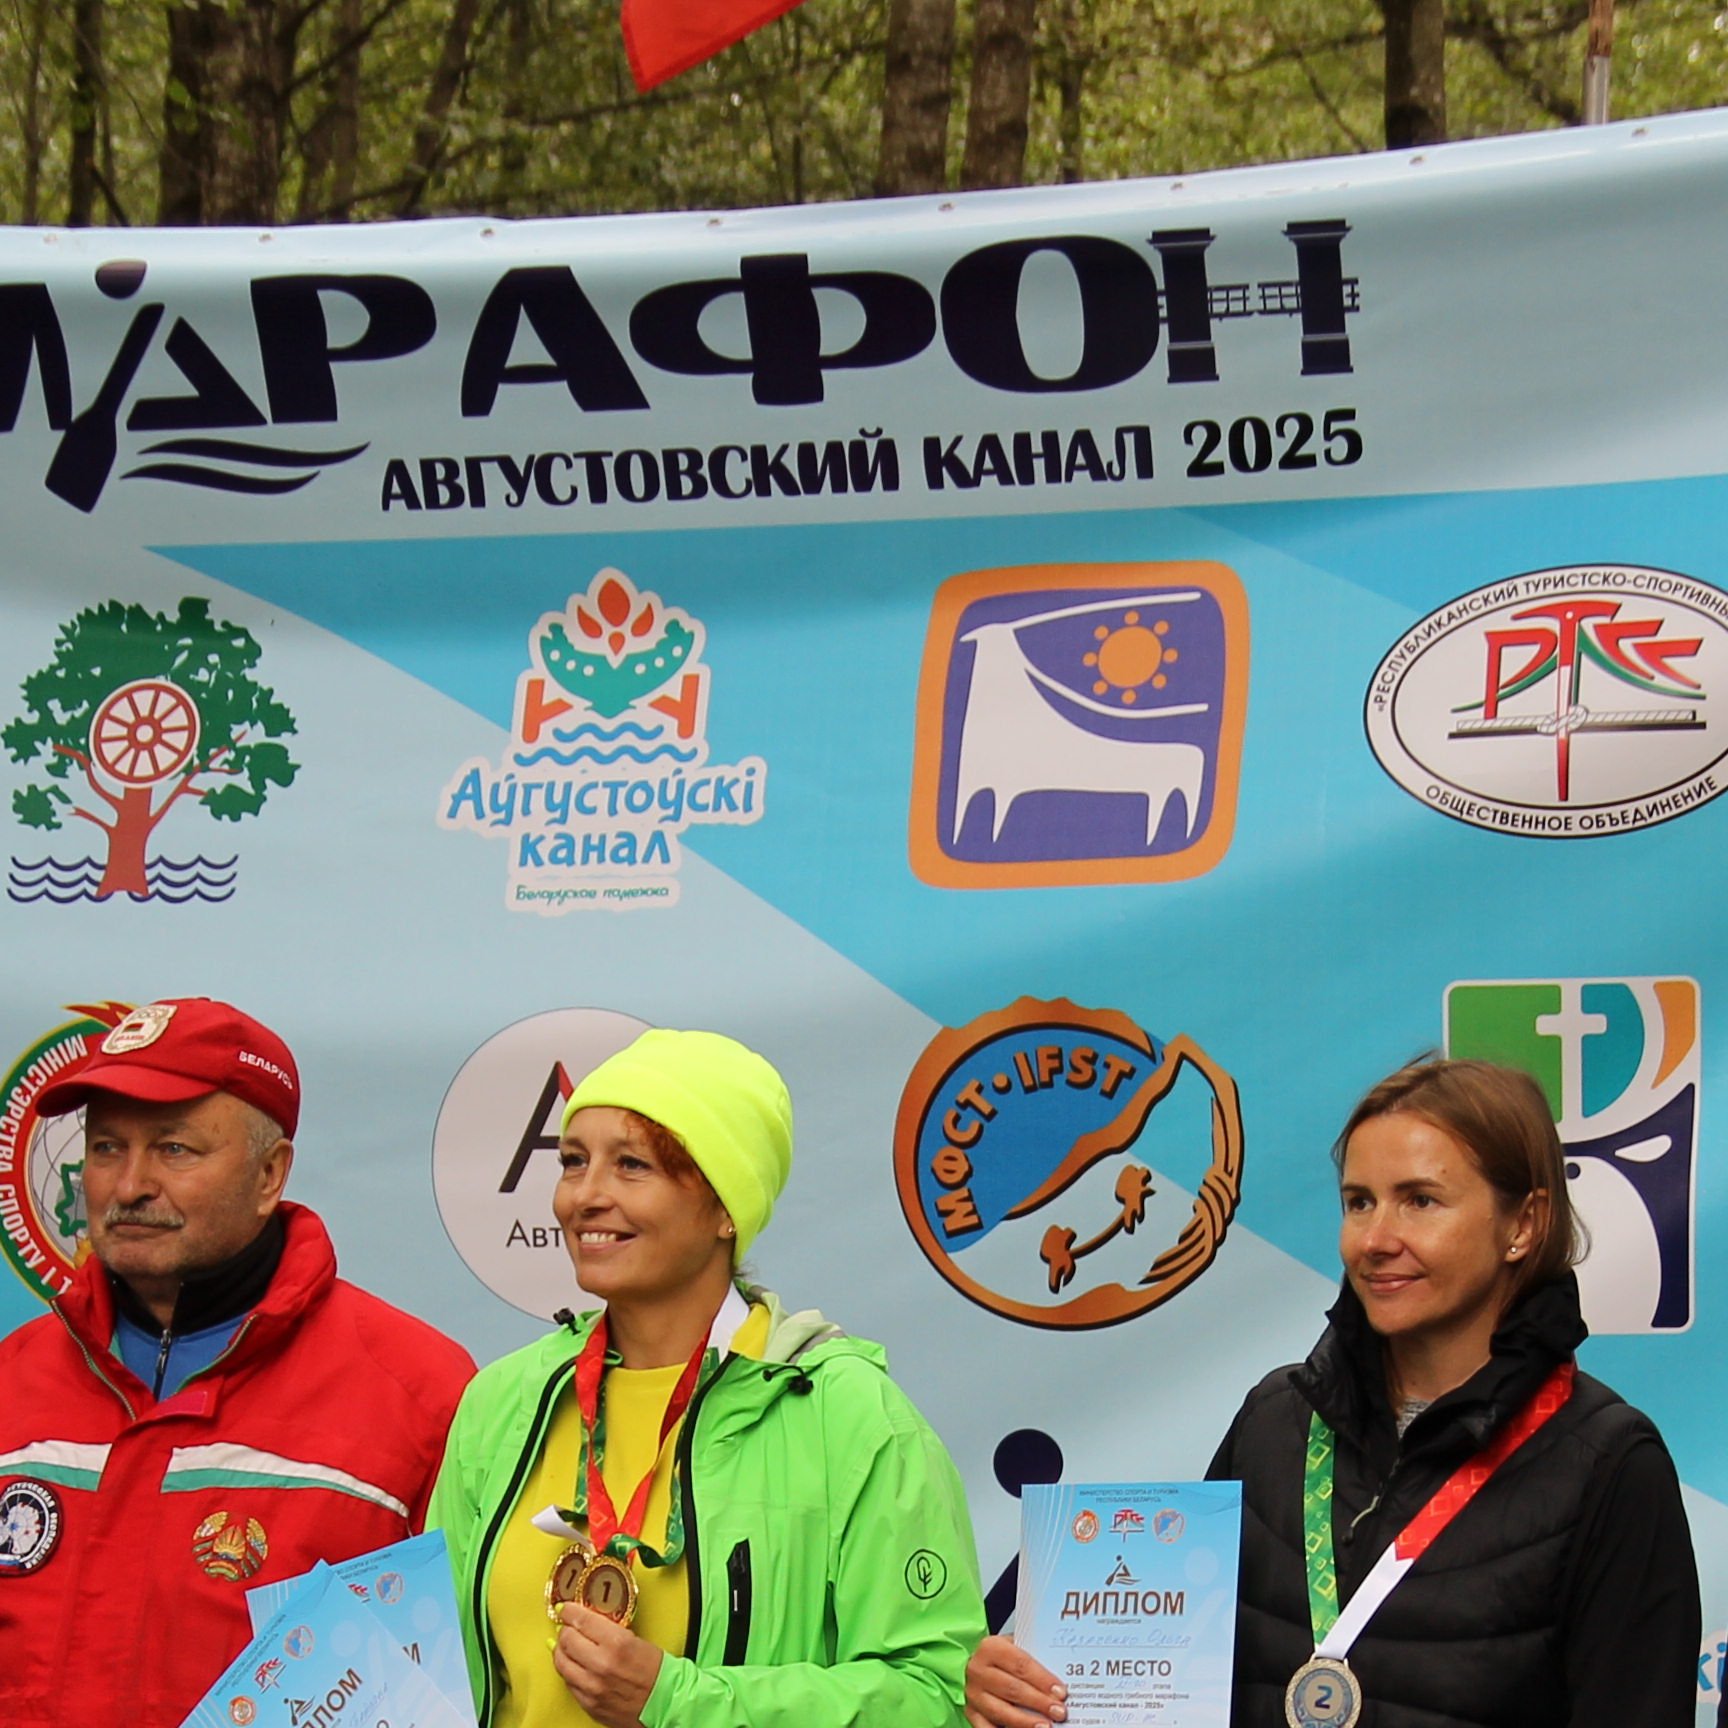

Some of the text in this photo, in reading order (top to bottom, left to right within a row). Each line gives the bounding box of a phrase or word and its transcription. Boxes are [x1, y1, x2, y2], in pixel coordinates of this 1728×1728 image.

[380, 408, 1364, 512] АВГУСТОВСКИЙ КАНАЛ 2025
[1374, 582, 1520, 713] «РЕСПУБЛИКАНСКИЙ
[446, 767, 757, 827] Аўгустоўскі
[1425, 774, 1719, 832] ОБЩЕСТВЕННОЕ ОБЪЕДИНЕНИЕ
[518, 829, 672, 868] канал
[602, 1580, 612, 1603] 1
[1060, 1591, 1185, 1620] ДИПЛОМ
[1065, 1659, 1172, 1676] за 2 МЕСТО
[1314, 1685, 1333, 1709] 2
